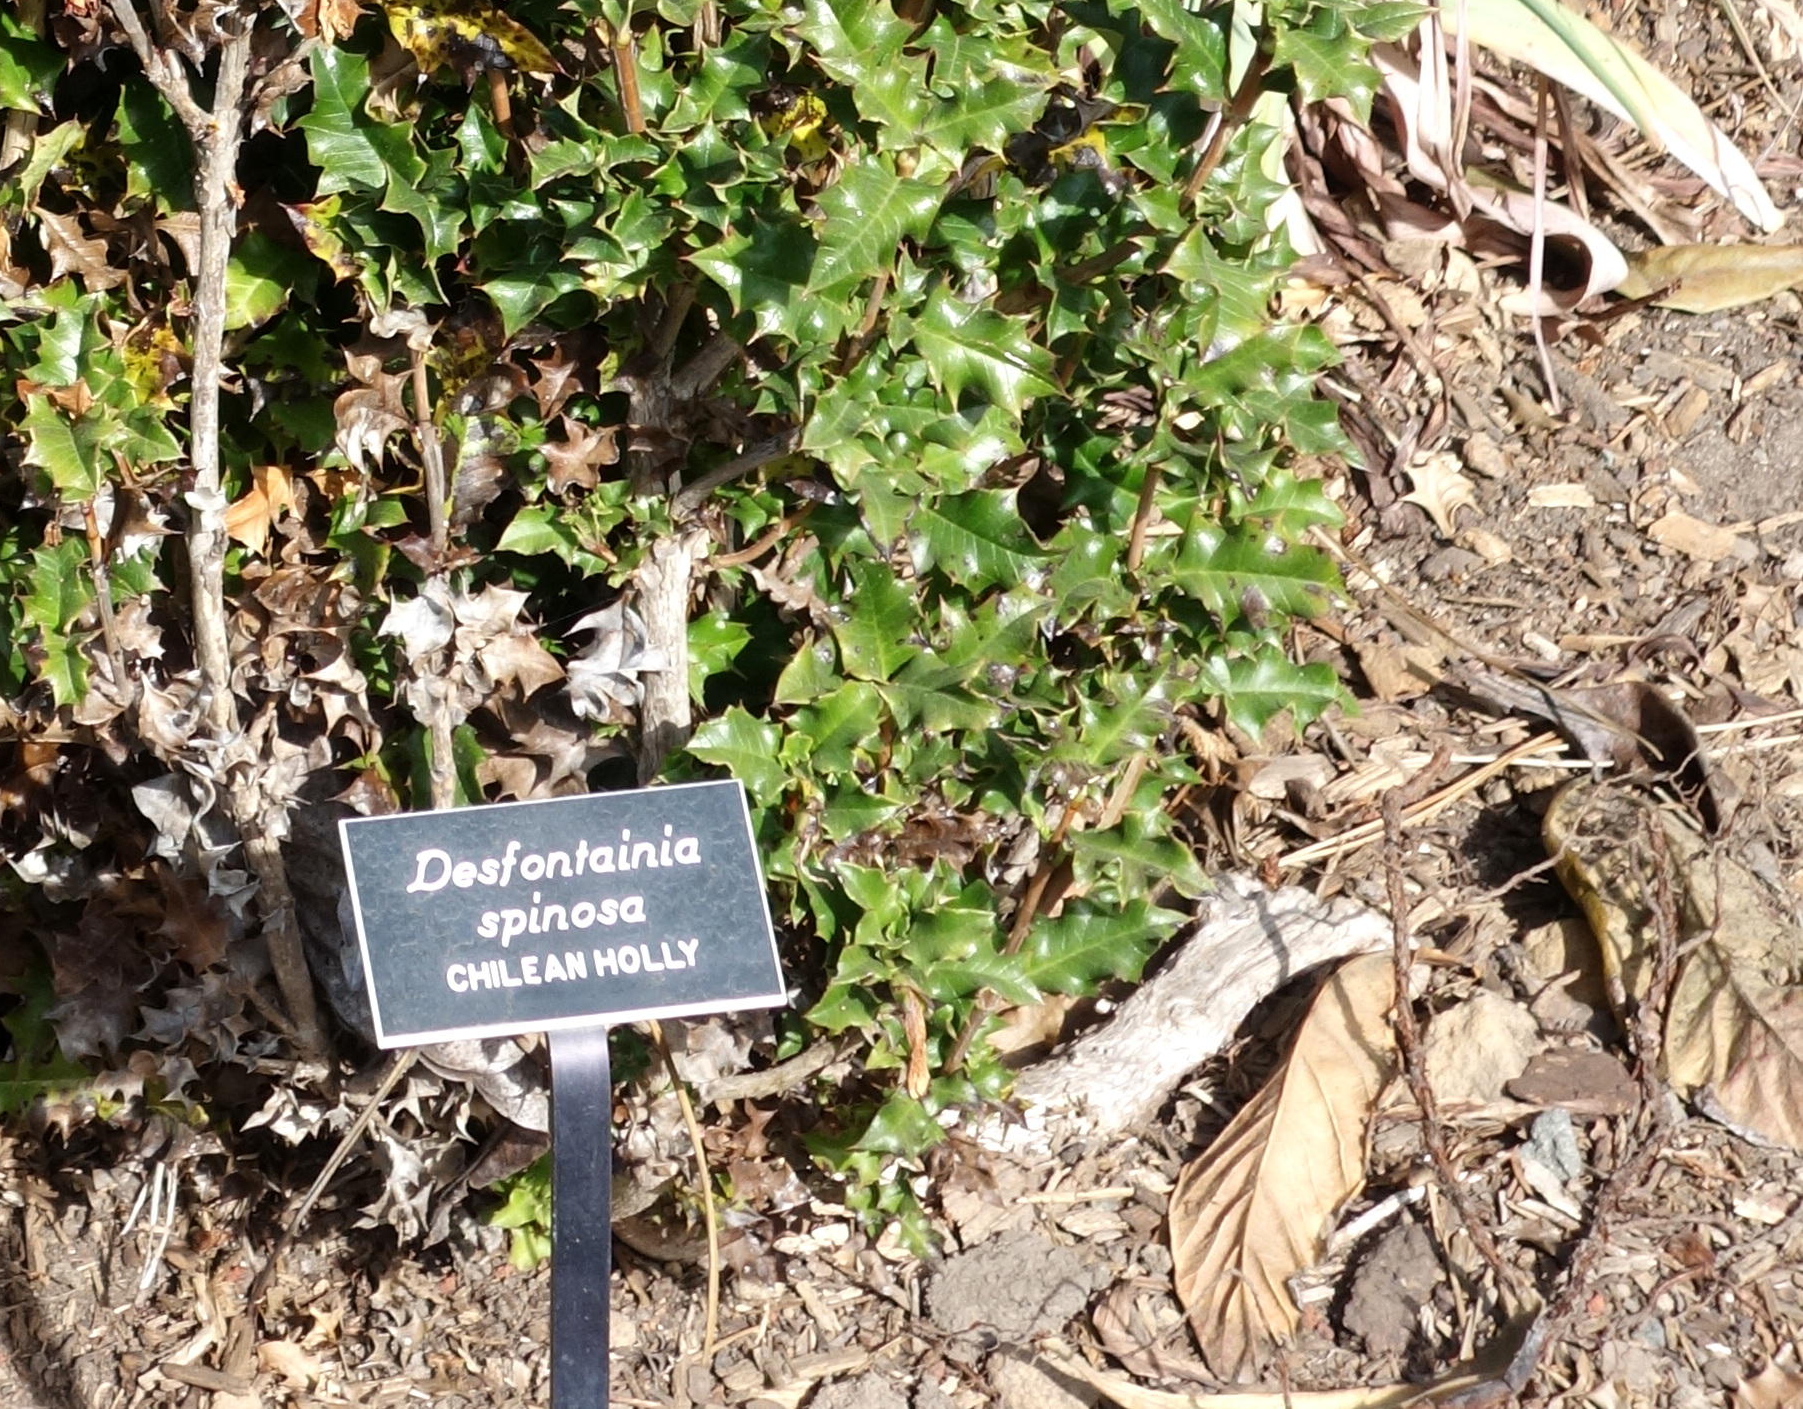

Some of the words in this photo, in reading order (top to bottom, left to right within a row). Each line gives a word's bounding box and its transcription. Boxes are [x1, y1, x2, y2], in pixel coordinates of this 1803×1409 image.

[406, 824, 702, 893] Desfontainia
[476, 891, 647, 948] spinosa
[445, 950, 588, 993] CHILEAN
[593, 938, 700, 976] HOLLY
